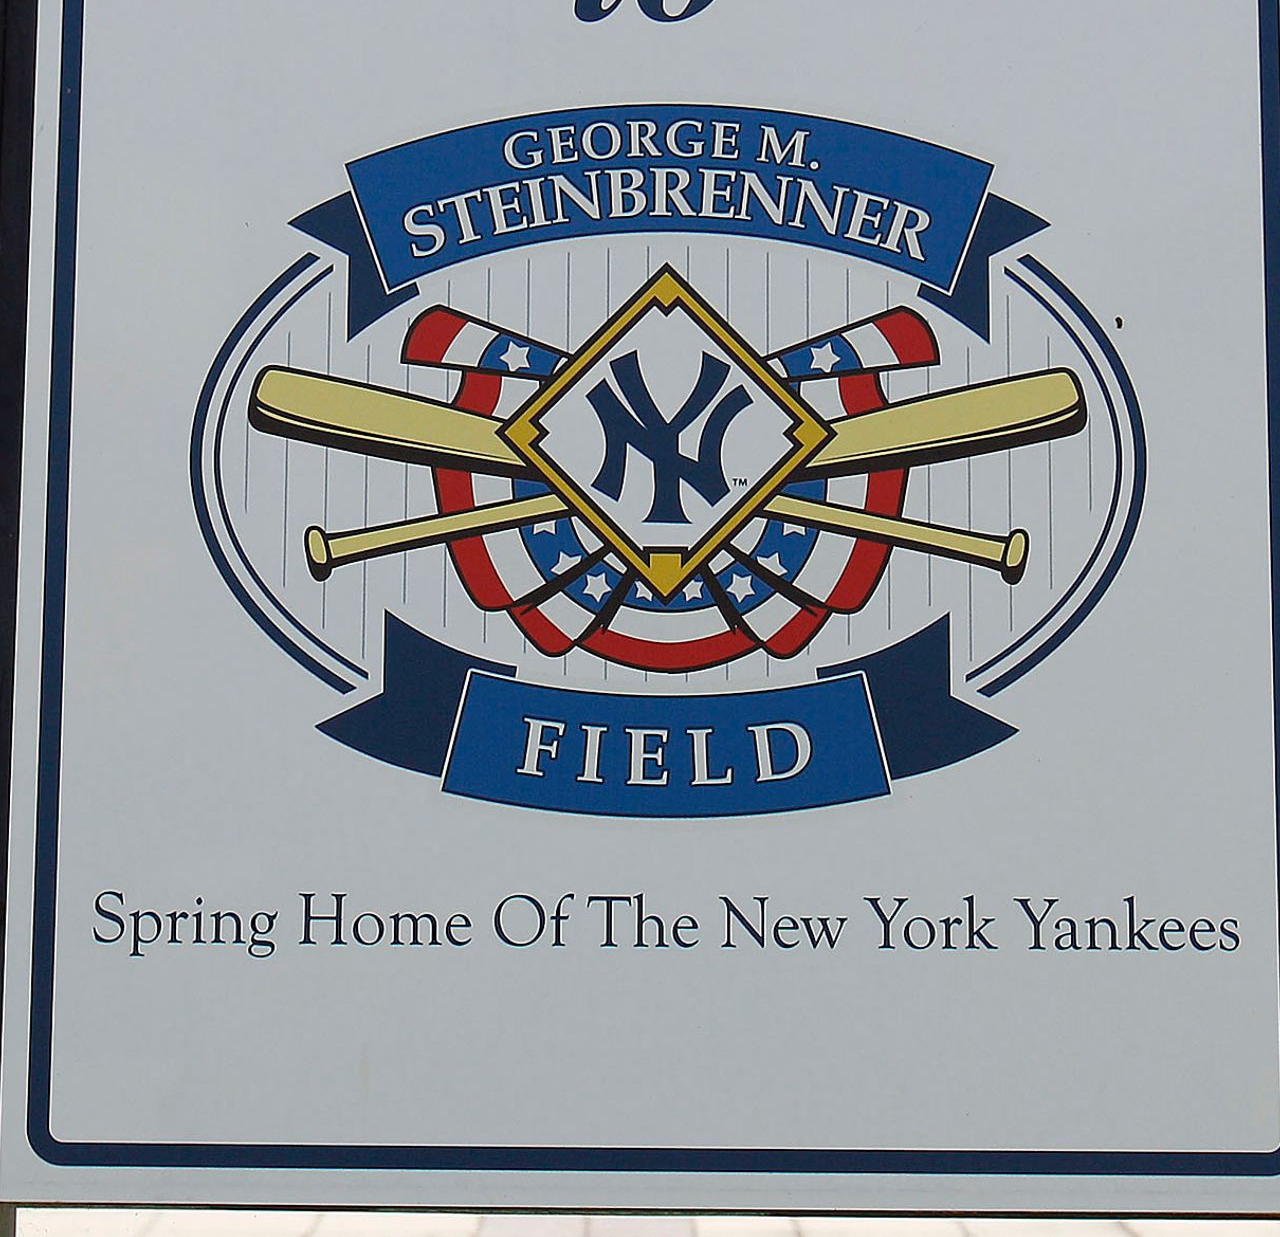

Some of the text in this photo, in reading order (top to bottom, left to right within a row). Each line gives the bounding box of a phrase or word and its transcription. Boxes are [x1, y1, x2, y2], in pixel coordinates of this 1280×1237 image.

[503, 120, 820, 170] GEORGE M.
[403, 167, 932, 262] STEINBRENNER
[517, 717, 812, 787] FIELD
[92, 890, 1240, 959] Spring Home Of The New York Yankees
